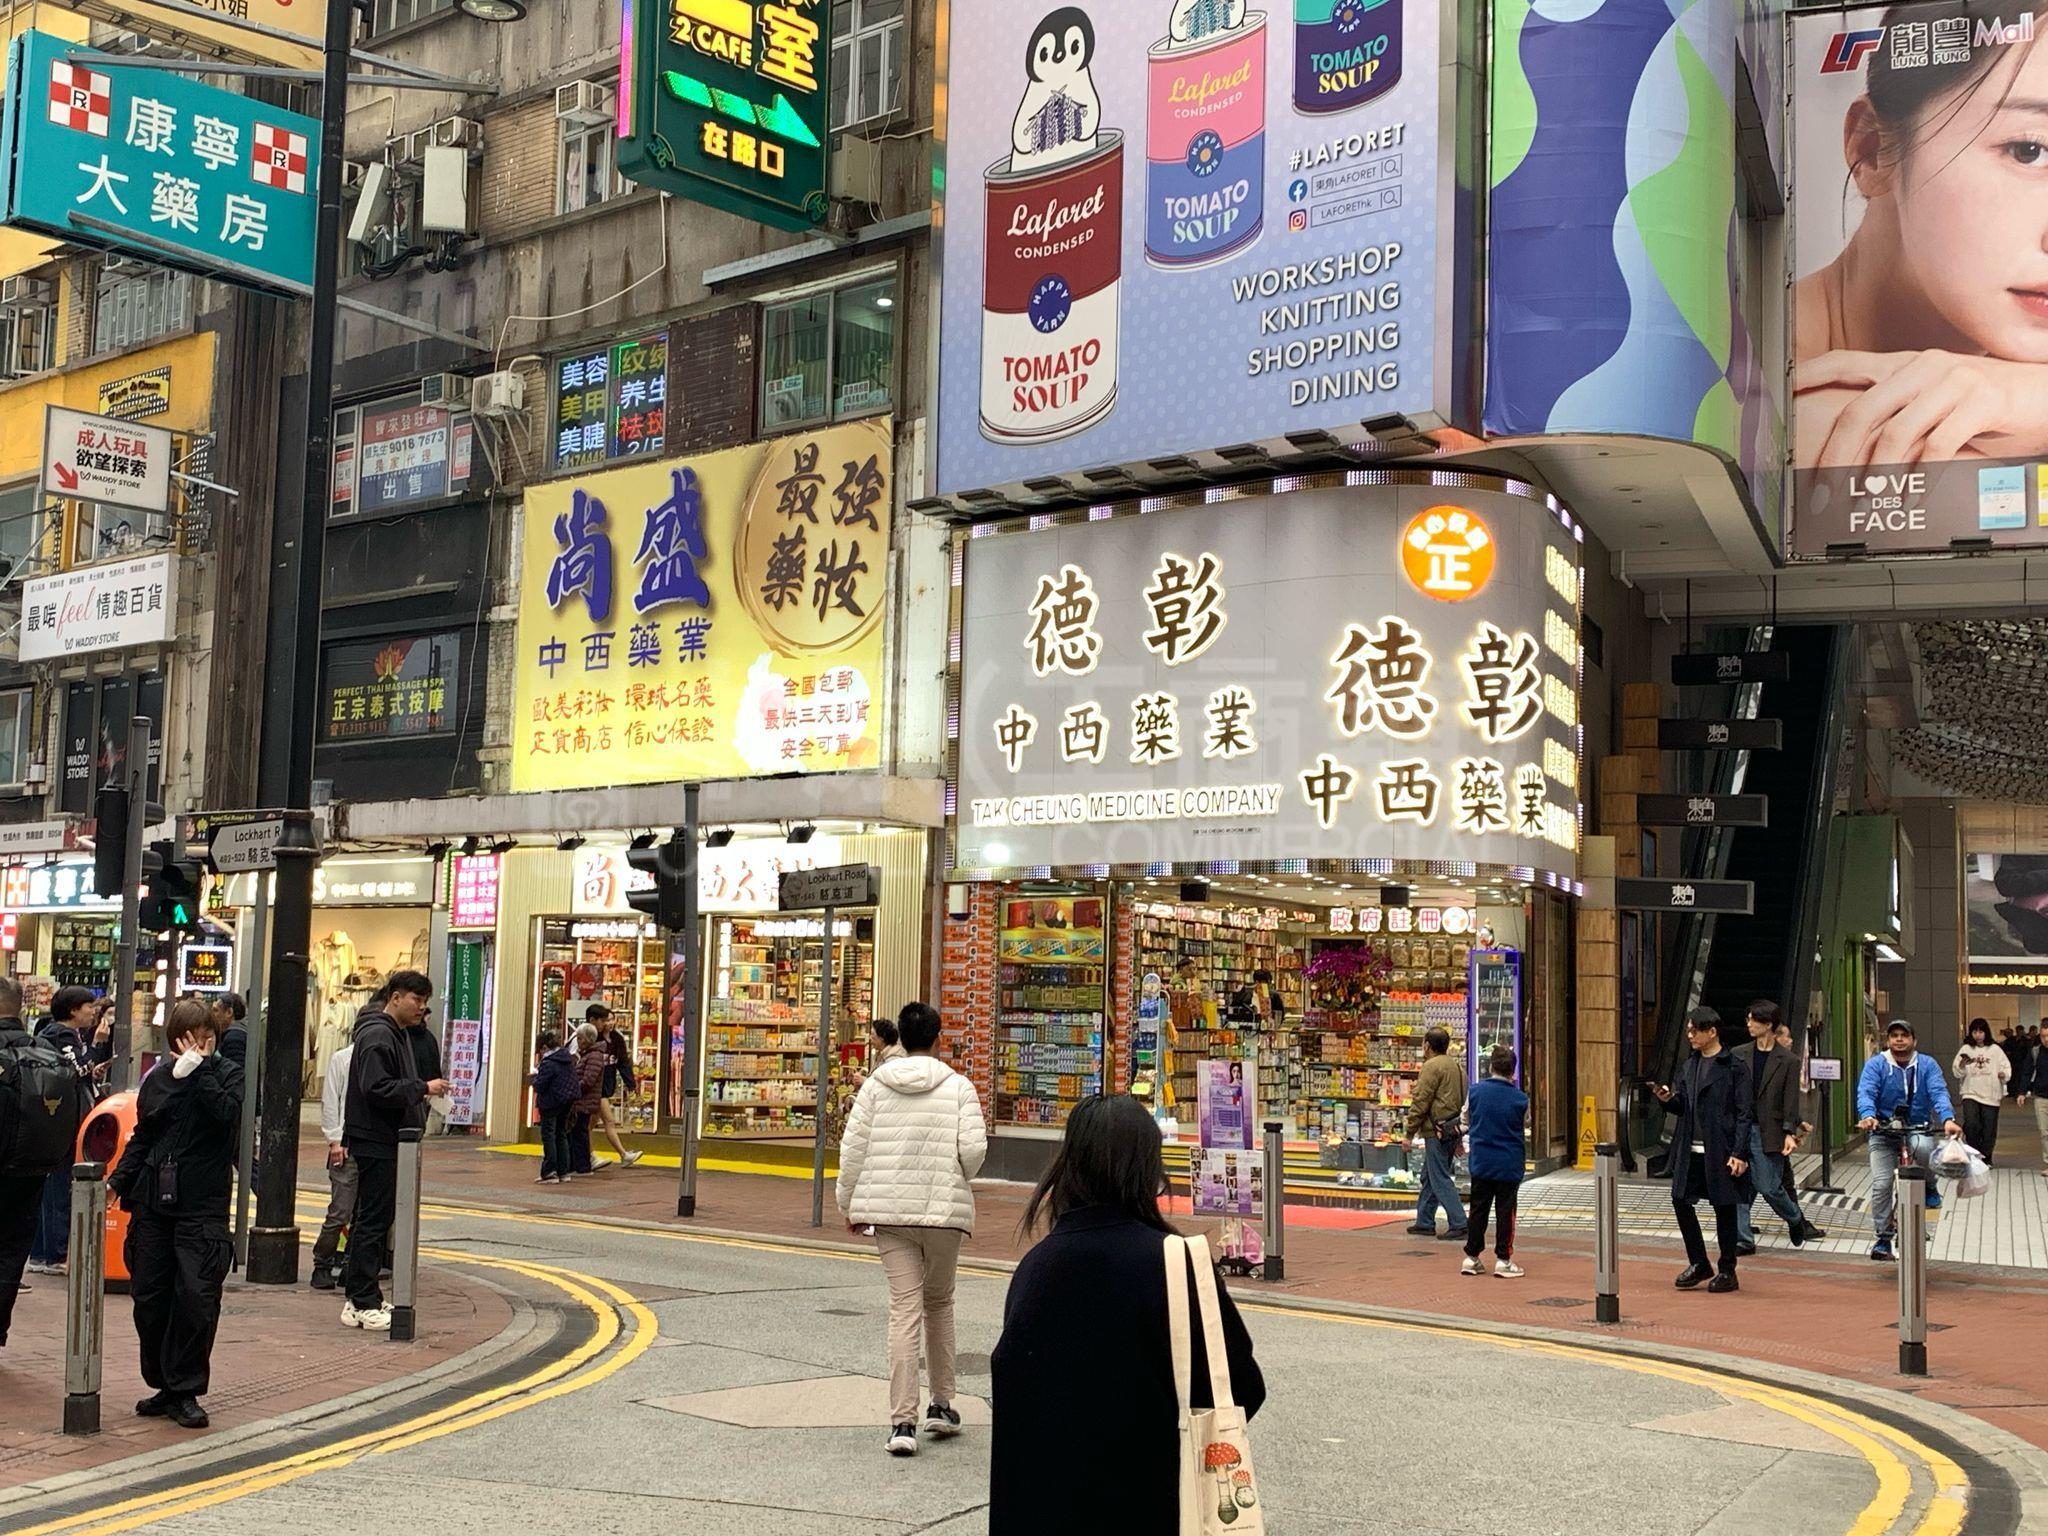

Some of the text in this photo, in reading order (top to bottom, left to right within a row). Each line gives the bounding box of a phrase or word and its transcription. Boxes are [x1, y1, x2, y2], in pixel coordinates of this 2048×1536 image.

[697, 27, 752, 66] CAFE
[1974, 12, 2034, 48] Mall
[1310, 34, 1389, 73] TOMATO
[1891, 50, 1970, 69] LUNG FUNG
[1168, 58, 1251, 106] Laforet
[1318, 59, 1380, 94] SOUP
[1174, 91, 1243, 118] CONDENSED
[125, 97, 239, 171] 康寧
[704, 121, 784, 178] 在路口
[1191, 136, 1221, 156] HAPPY
[1289, 122, 1406, 172] #LAFORET
[1194, 160, 1218, 176] YARN
[76, 153, 268, 250] 大藥房
[1007, 184, 1104, 242] Laforet
[1165, 179, 1249, 219] TOMATO
[1015, 228, 1094, 259] CONDENSED
[1173, 208, 1239, 244] SOUP
[1232, 243, 1402, 303] WORKSHOP
[1033, 280, 1070, 305] HAPPY
[1261, 283, 1400, 335] KNITTING
[1036, 310, 1065, 331] YARN
[1003, 338, 1100, 382] TOMATO
[1247, 323, 1399, 376] SHOPPING
[562, 355, 607, 390] 美容
[1290, 363, 1398, 407] DINING
[561, 389, 605, 423] 美甲
[620, 374, 665, 409] 养生
[1013, 373, 1088, 413] SOUP
[77, 429, 147, 459] 成人玩具
[389, 439, 415, 453] 9018
[559, 421, 605, 456] 美睫
[76, 448, 147, 478] 欲望探索
[92, 475, 140, 489] WADDY STORE
[382, 473, 422, 500] 出售
[776, 442, 885, 531] 最強
[1850, 509, 1926, 532] FACE
[1872, 497, 1902, 509] DES
[546, 467, 711, 622] 尚盛
[1424, 543, 1472, 591] 正
[56, 586, 95, 639] feel
[96, 583, 162, 620] 情趣百貨
[1024, 552, 1226, 676] 德彰
[76, 632, 120, 648] WADDY STORE
[538, 616, 711, 679] 中西藥業
[333, 686, 364, 698] PERFECT
[367, 684, 384, 695] THAI
[430, 678, 445, 687] SPA
[783, 670, 854, 697] 全國包郵
[1327, 618, 1541, 740] 德彰
[332, 688, 445, 720] 正宗泰式按摩
[533, 676, 715, 722] 歐美彩妝 環球名藥
[764, 700, 870, 731] 最快三天到貨
[530, 717, 715, 755] 正貨商店 信心保證
[996, 686, 1257, 771] 中西藥業
[780, 734, 851, 759] 安全可靠
[67, 767, 89, 779] STORE
[974, 786, 1279, 822] TAK CHEUNG MEDICINE COMPANY
[1304, 760, 1545, 832] 中西藥業
[234, 829, 271, 842] Lockhart
[248, 847, 276, 863] 駱克
[808, 869, 866, 885] Lockhart Road
[1330, 908, 1441, 934] 政府註冊
